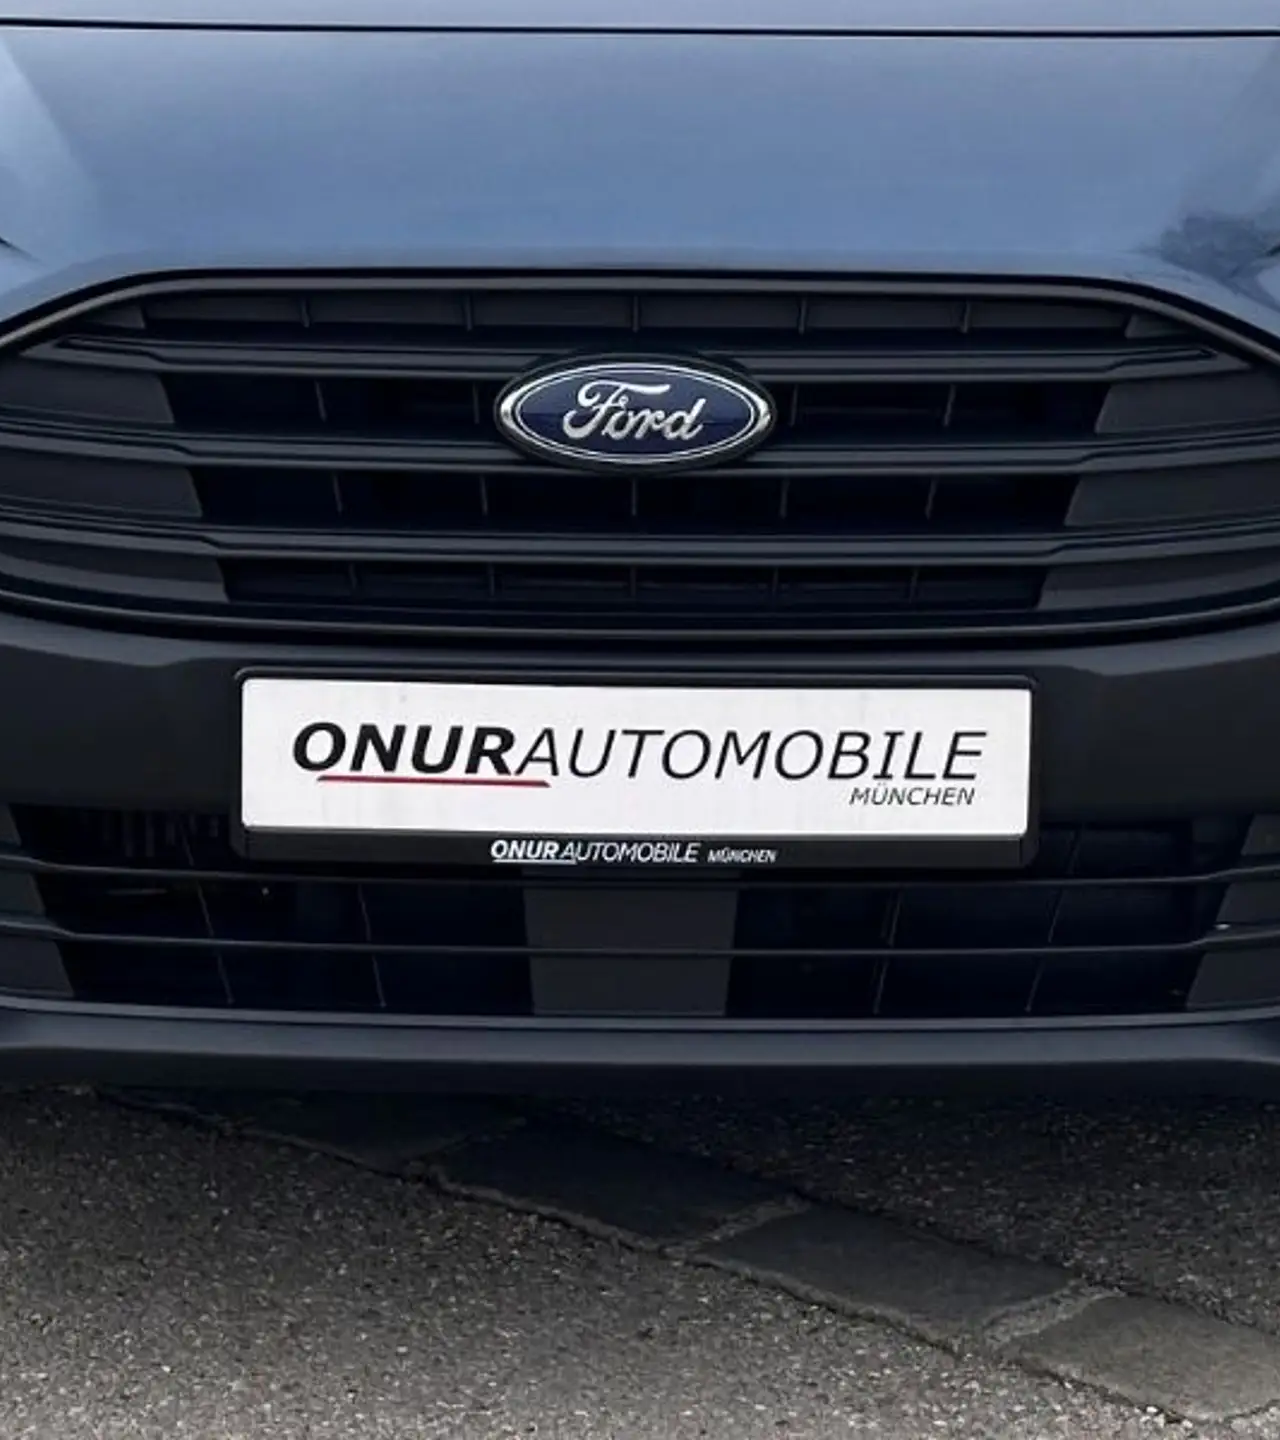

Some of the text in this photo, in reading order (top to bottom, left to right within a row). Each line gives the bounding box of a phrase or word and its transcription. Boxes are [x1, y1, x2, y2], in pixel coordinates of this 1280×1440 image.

[562, 379, 707, 440] Ford
[849, 783, 975, 806] MÜNCHEN
[707, 847, 777, 863] MÜNCHEN
